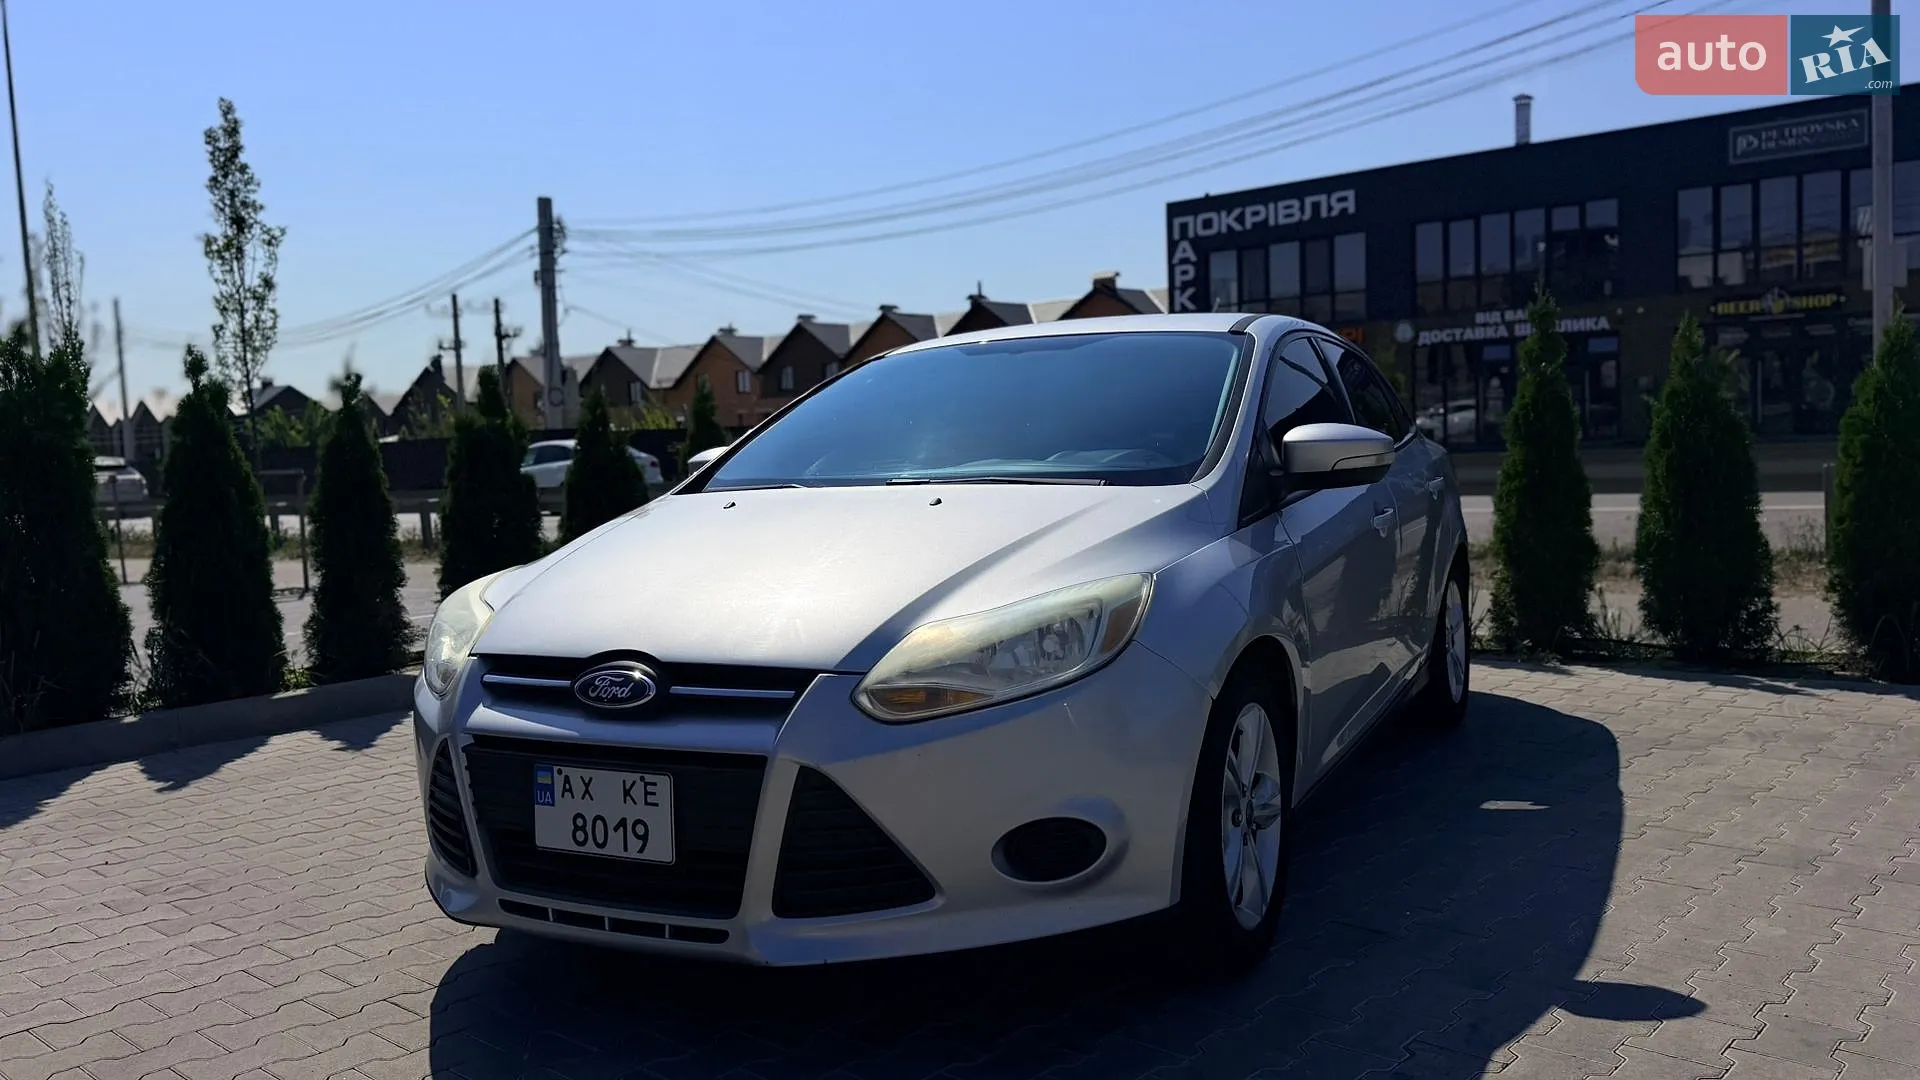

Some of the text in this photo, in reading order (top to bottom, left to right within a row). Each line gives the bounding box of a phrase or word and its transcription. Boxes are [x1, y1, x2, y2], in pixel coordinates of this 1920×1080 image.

[1172, 189, 1356, 241] ПОКРІВЛЯ
[1716, 293, 1837, 315] BEER SHOP
[1475, 310, 1502, 325] ВІД
[1417, 325, 1508, 346] ДОСТАВКА
[588, 675, 635, 699] Ford
[536, 790, 553, 804] UA
[560, 774, 660, 808] AX KE
[571, 812, 650, 854] 8019
